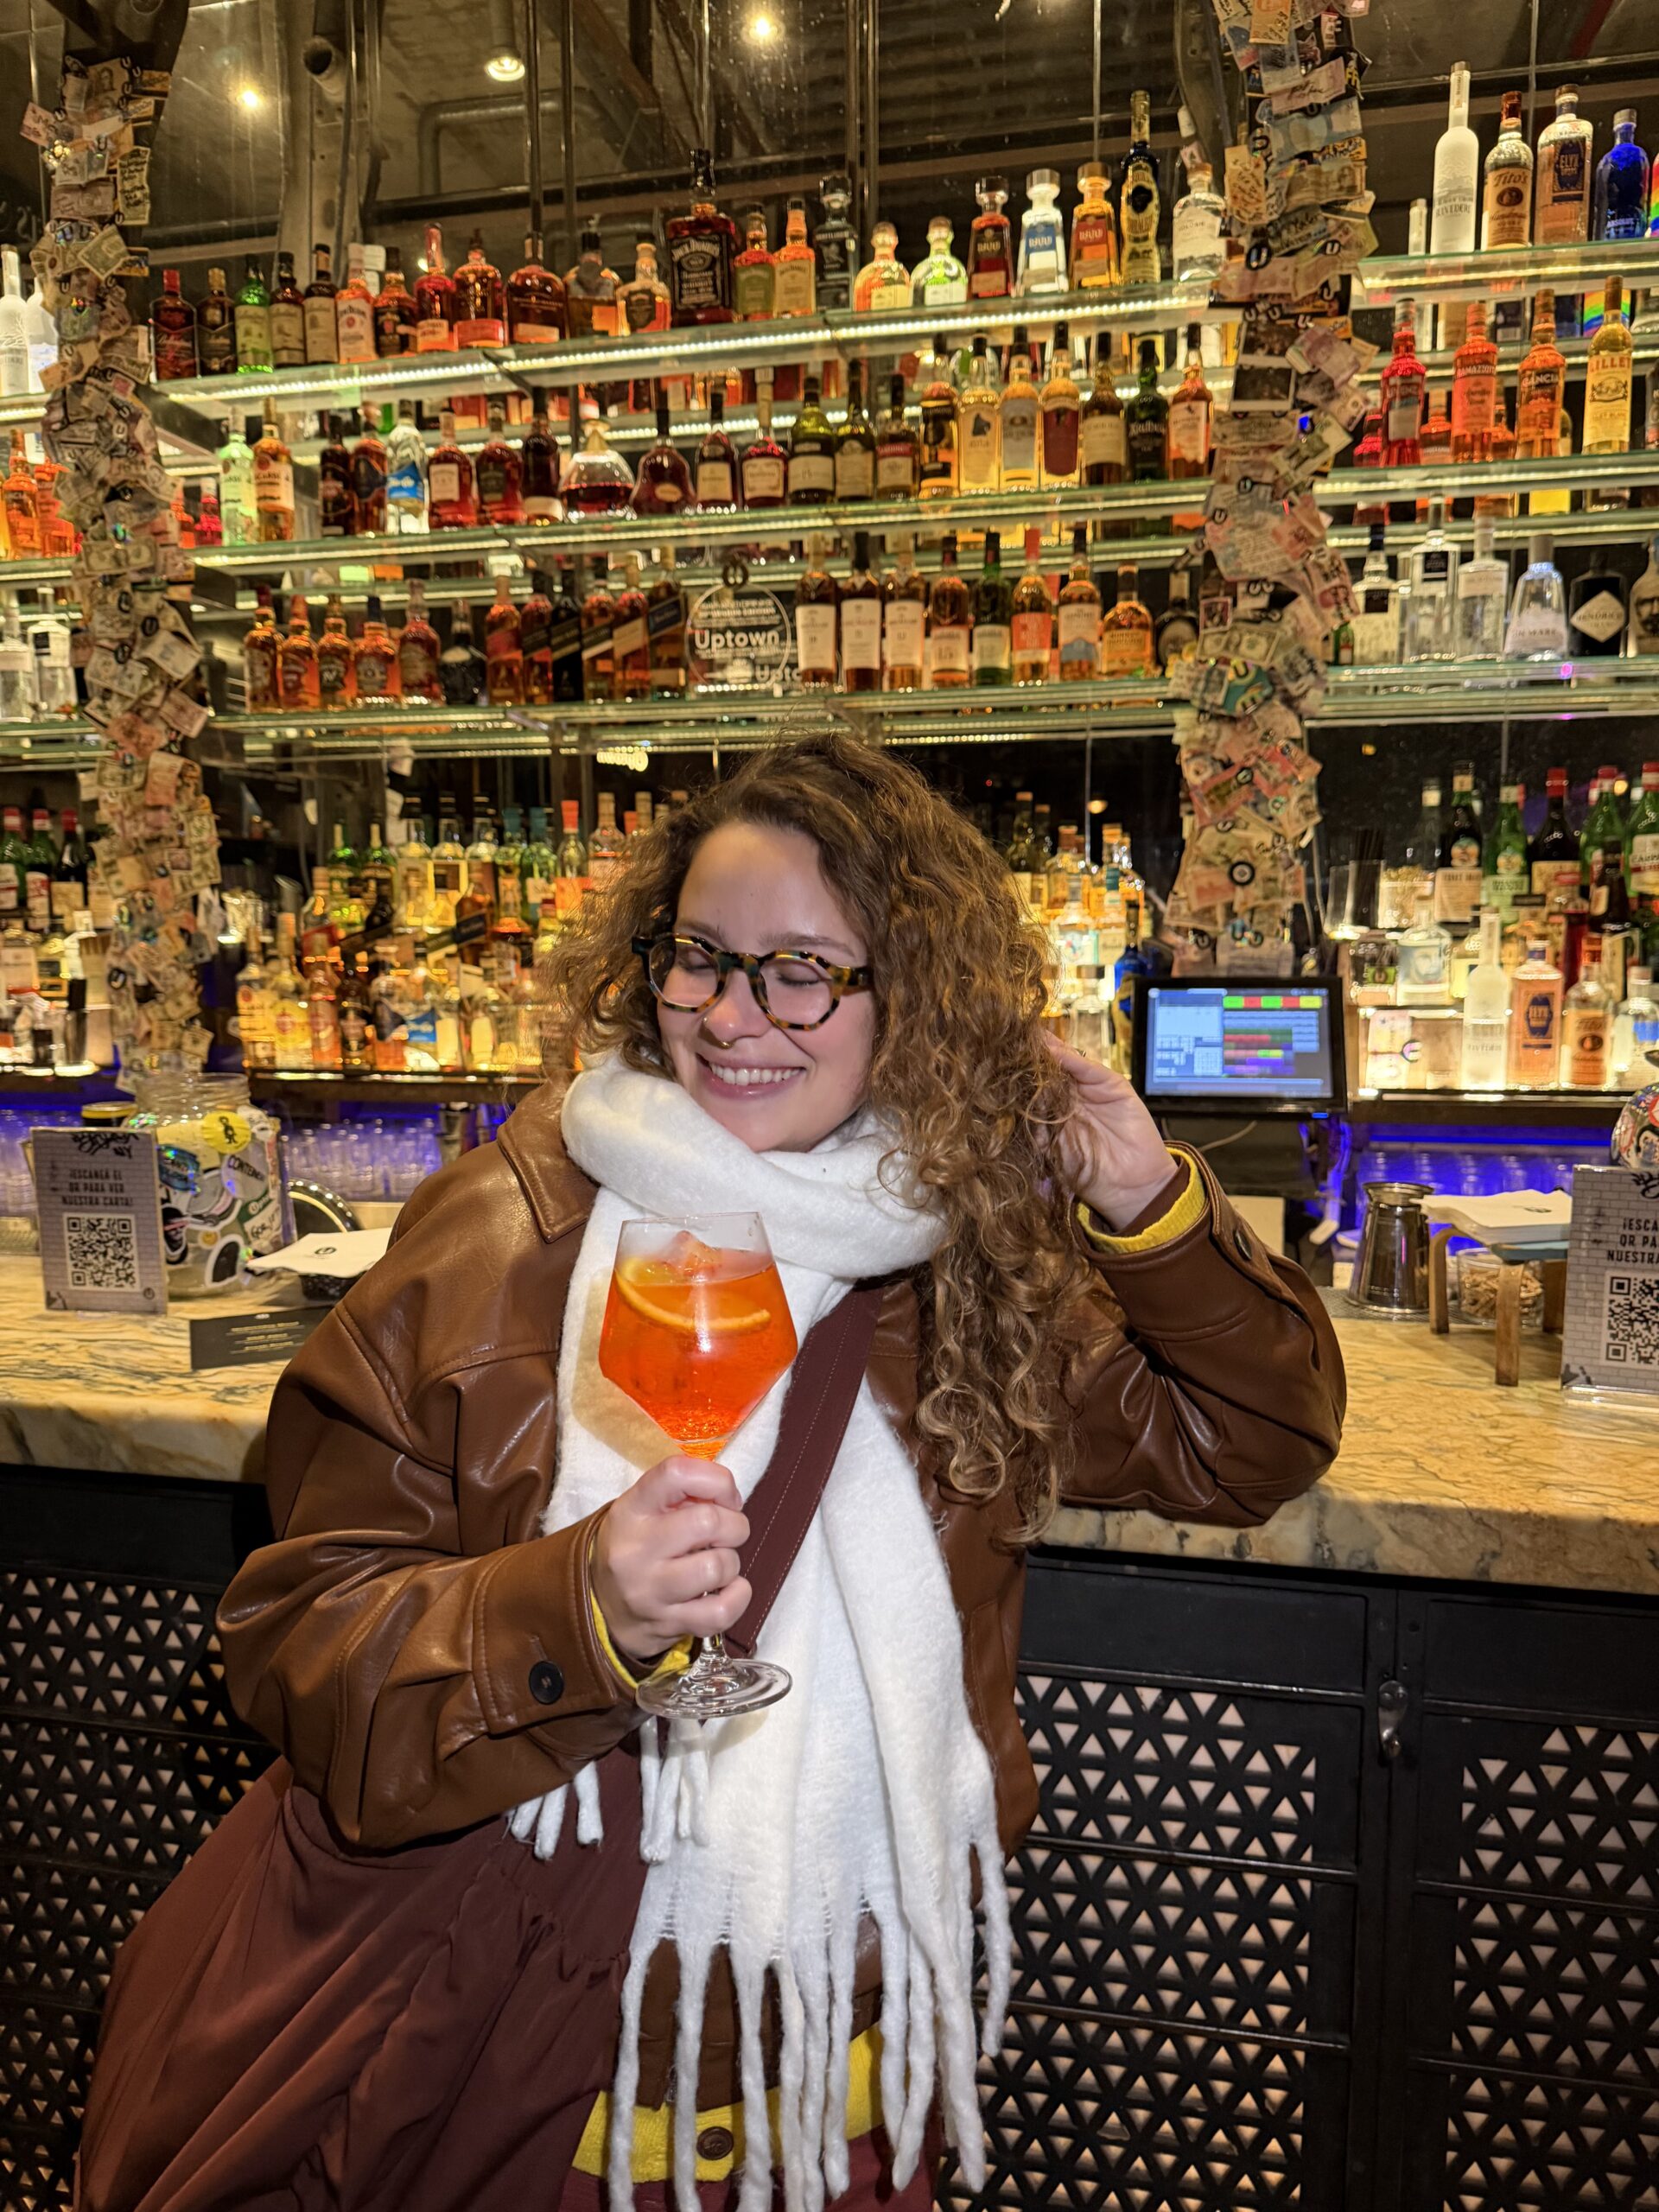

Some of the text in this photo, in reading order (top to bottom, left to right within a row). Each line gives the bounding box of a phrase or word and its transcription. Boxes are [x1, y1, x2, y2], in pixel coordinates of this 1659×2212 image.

[1560, 154, 1580, 168] ELYX
[1494, 171, 1528, 187] Tito's
[1326, 242, 1338, 254] U
[695, 628, 779, 654] Uptown
[113, 1169, 122, 1180] EL
[69, 1182, 124, 1193] QR PARA VER
[62, 1196, 133, 1206] NUESTRA CARTA!
[1620, 1234, 1636, 1247] QR
